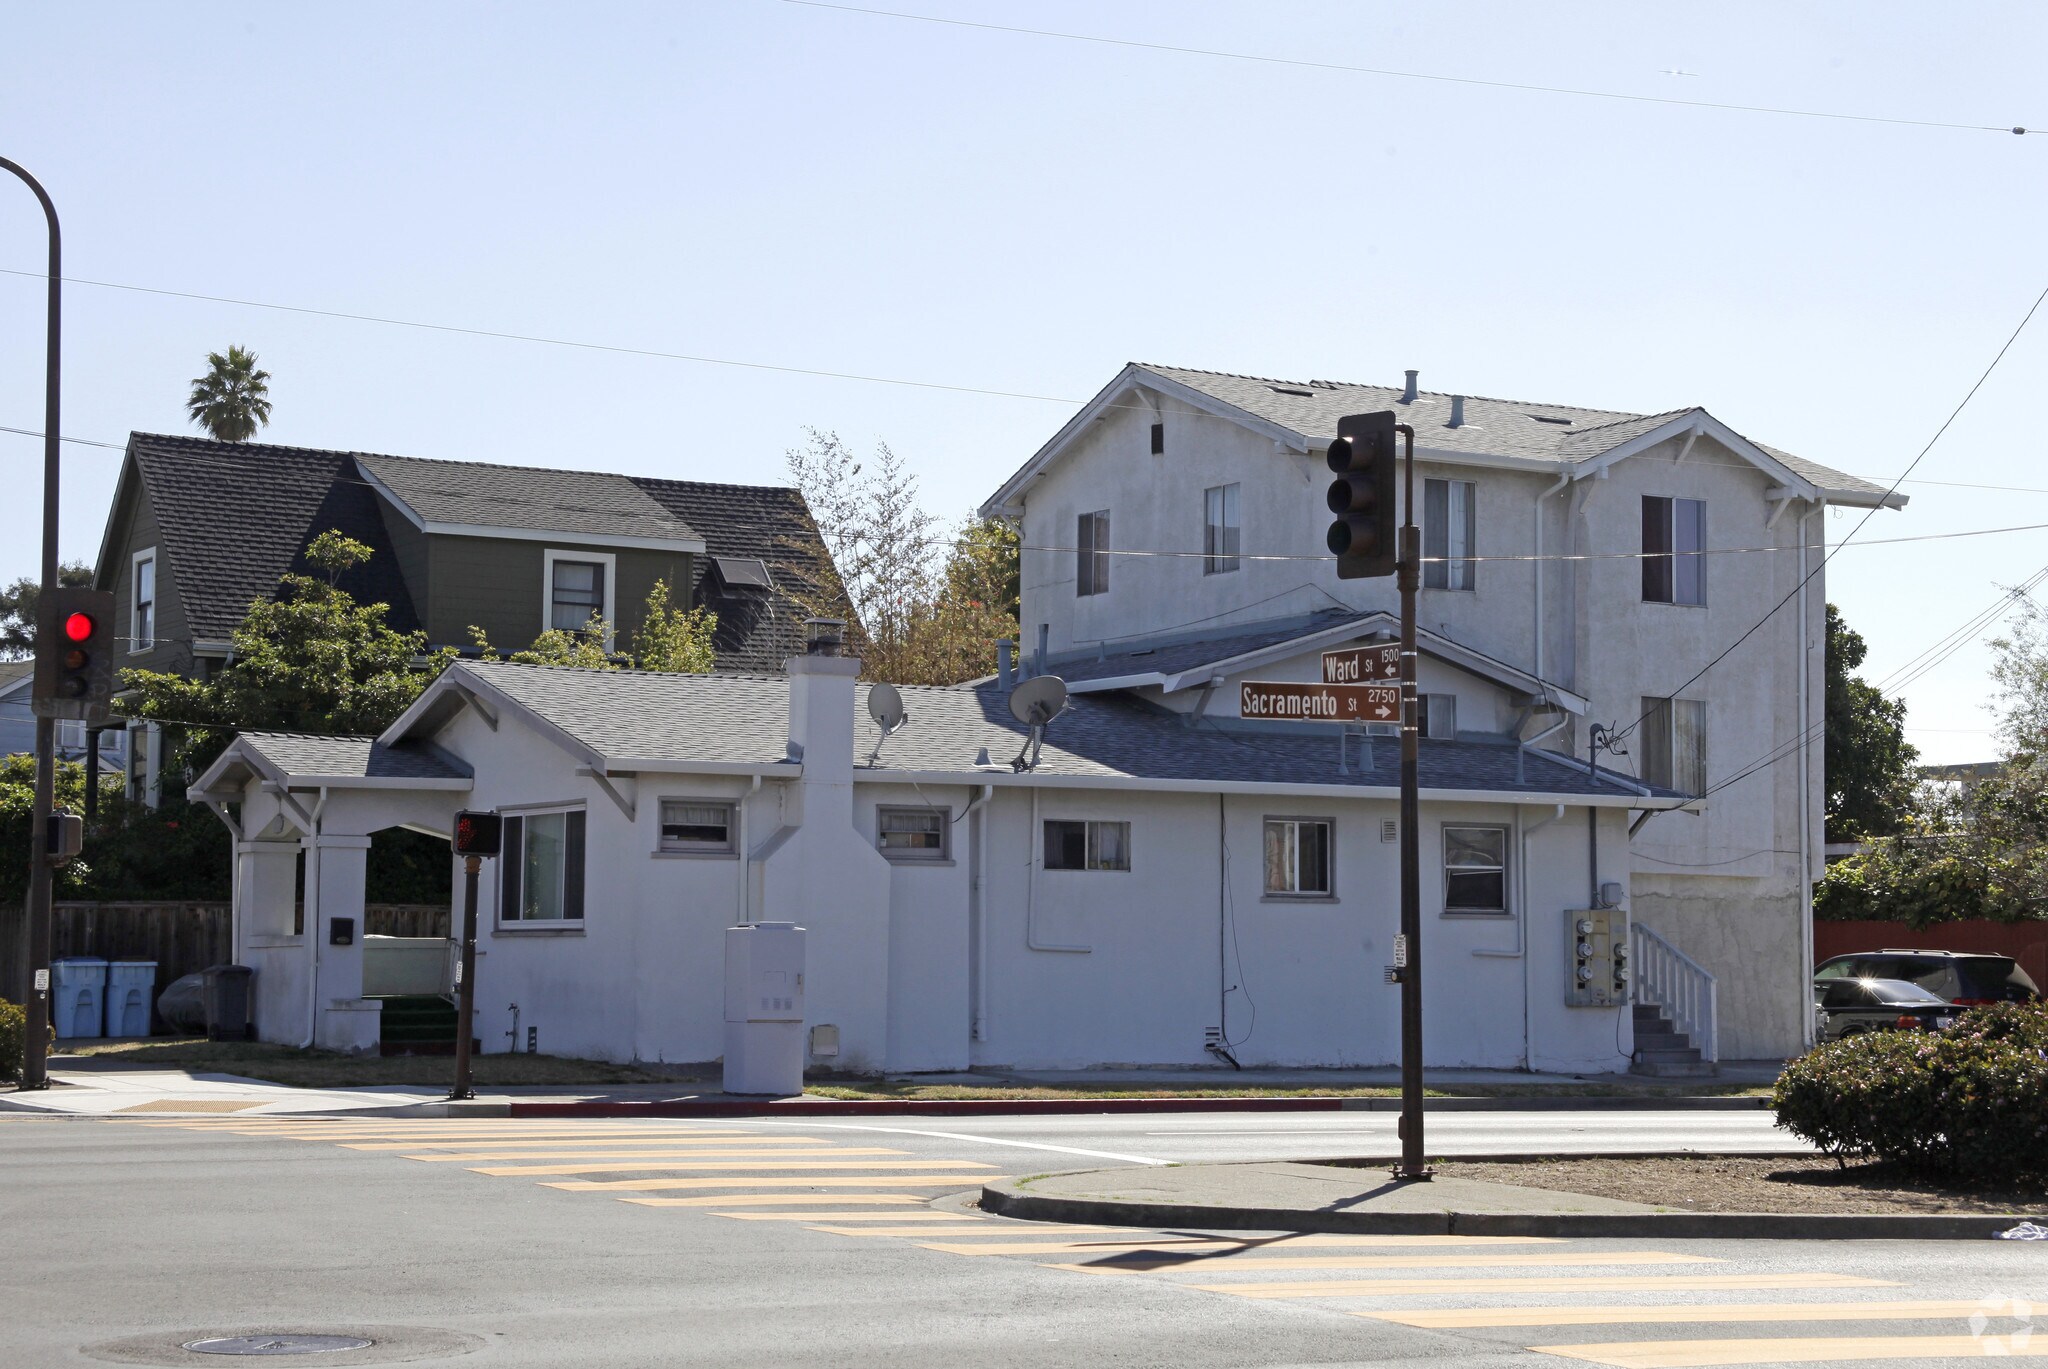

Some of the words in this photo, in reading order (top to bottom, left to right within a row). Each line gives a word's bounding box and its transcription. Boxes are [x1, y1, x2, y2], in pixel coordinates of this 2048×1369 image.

[1326, 654, 1359, 682] Ward
[1365, 659, 1373, 673] St
[1381, 649, 1399, 663] 1500
[1243, 687, 1337, 716] Sacramento
[1348, 697, 1357, 712] St
[1368, 689, 1396, 703] 2750
